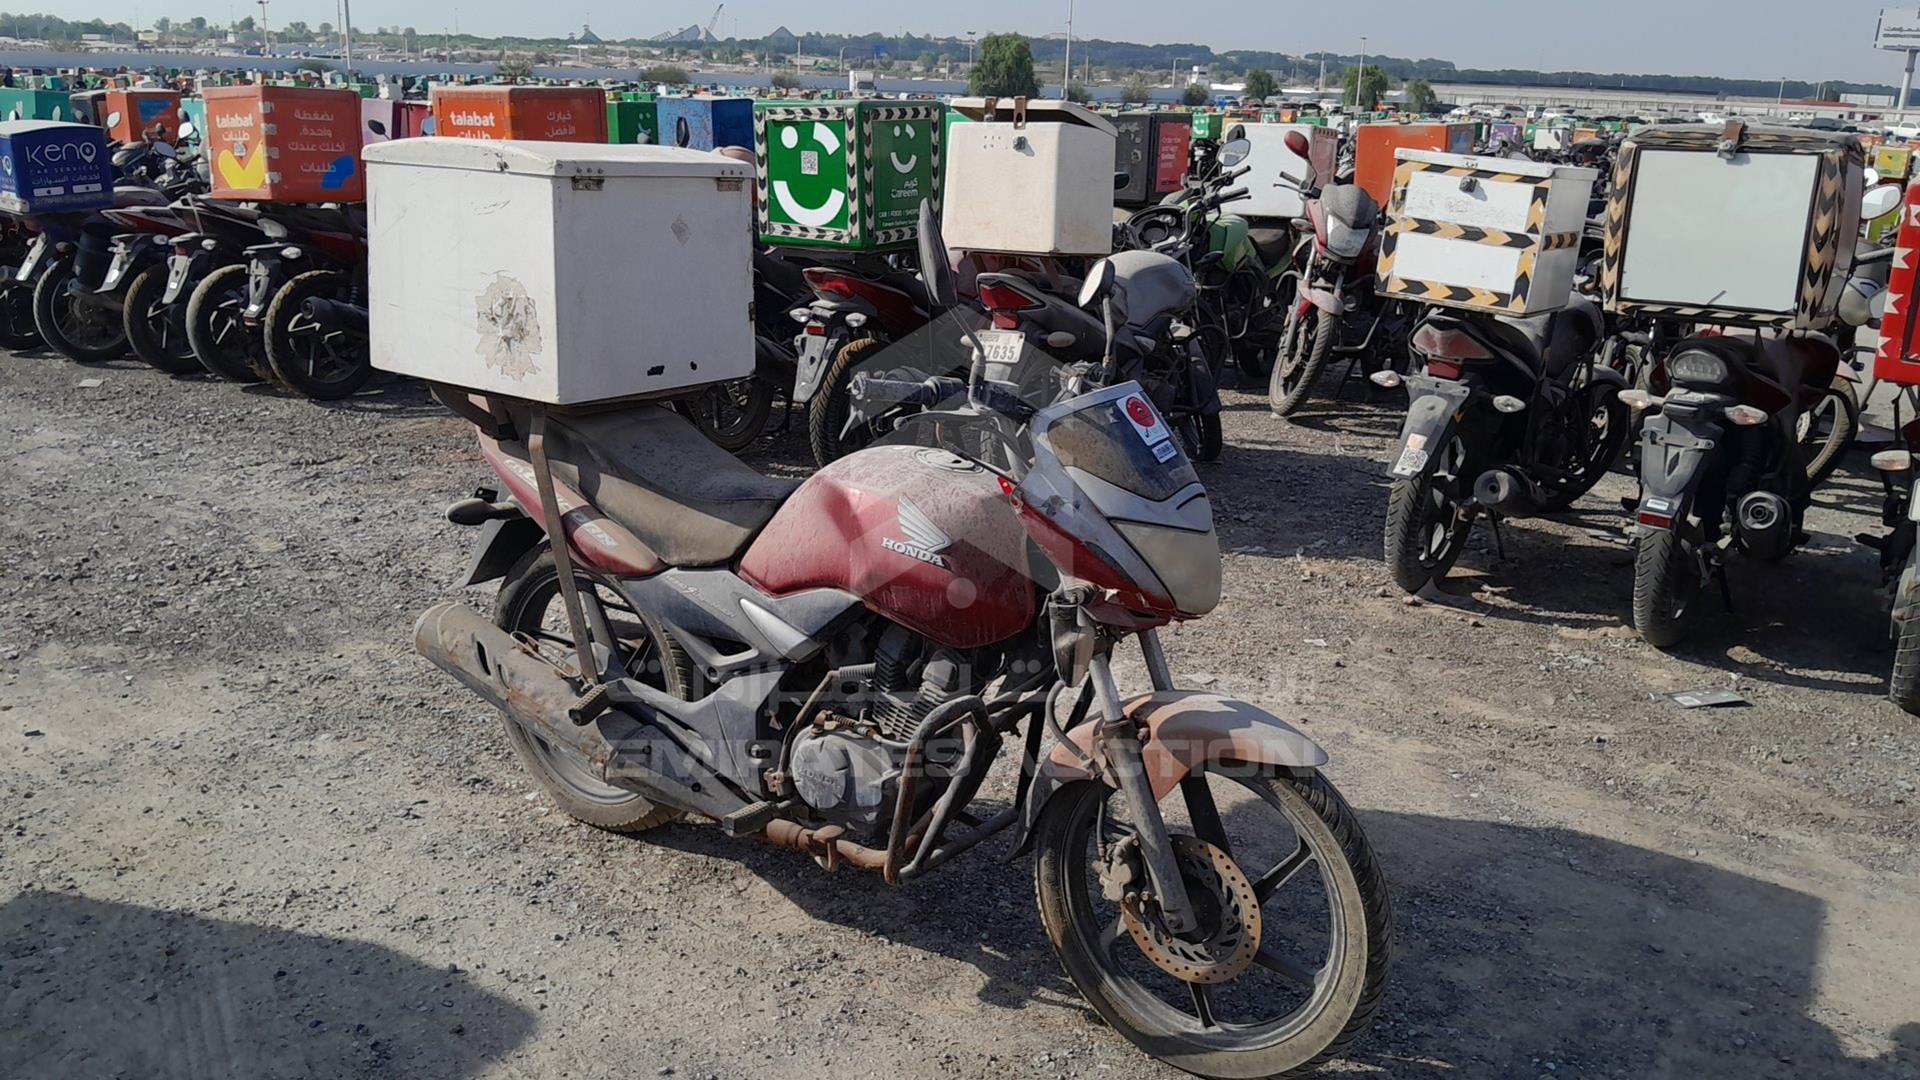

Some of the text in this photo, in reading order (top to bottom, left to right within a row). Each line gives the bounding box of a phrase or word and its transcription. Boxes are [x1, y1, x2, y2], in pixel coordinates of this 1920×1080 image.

[216, 112, 254, 128] talabat
[450, 110, 495, 127] talabat
[222, 128, 250, 142] طلبات
[300, 161, 337, 175] طلبات
[890, 188, 919, 198] Careem
[879, 536, 946, 568] HONDA
